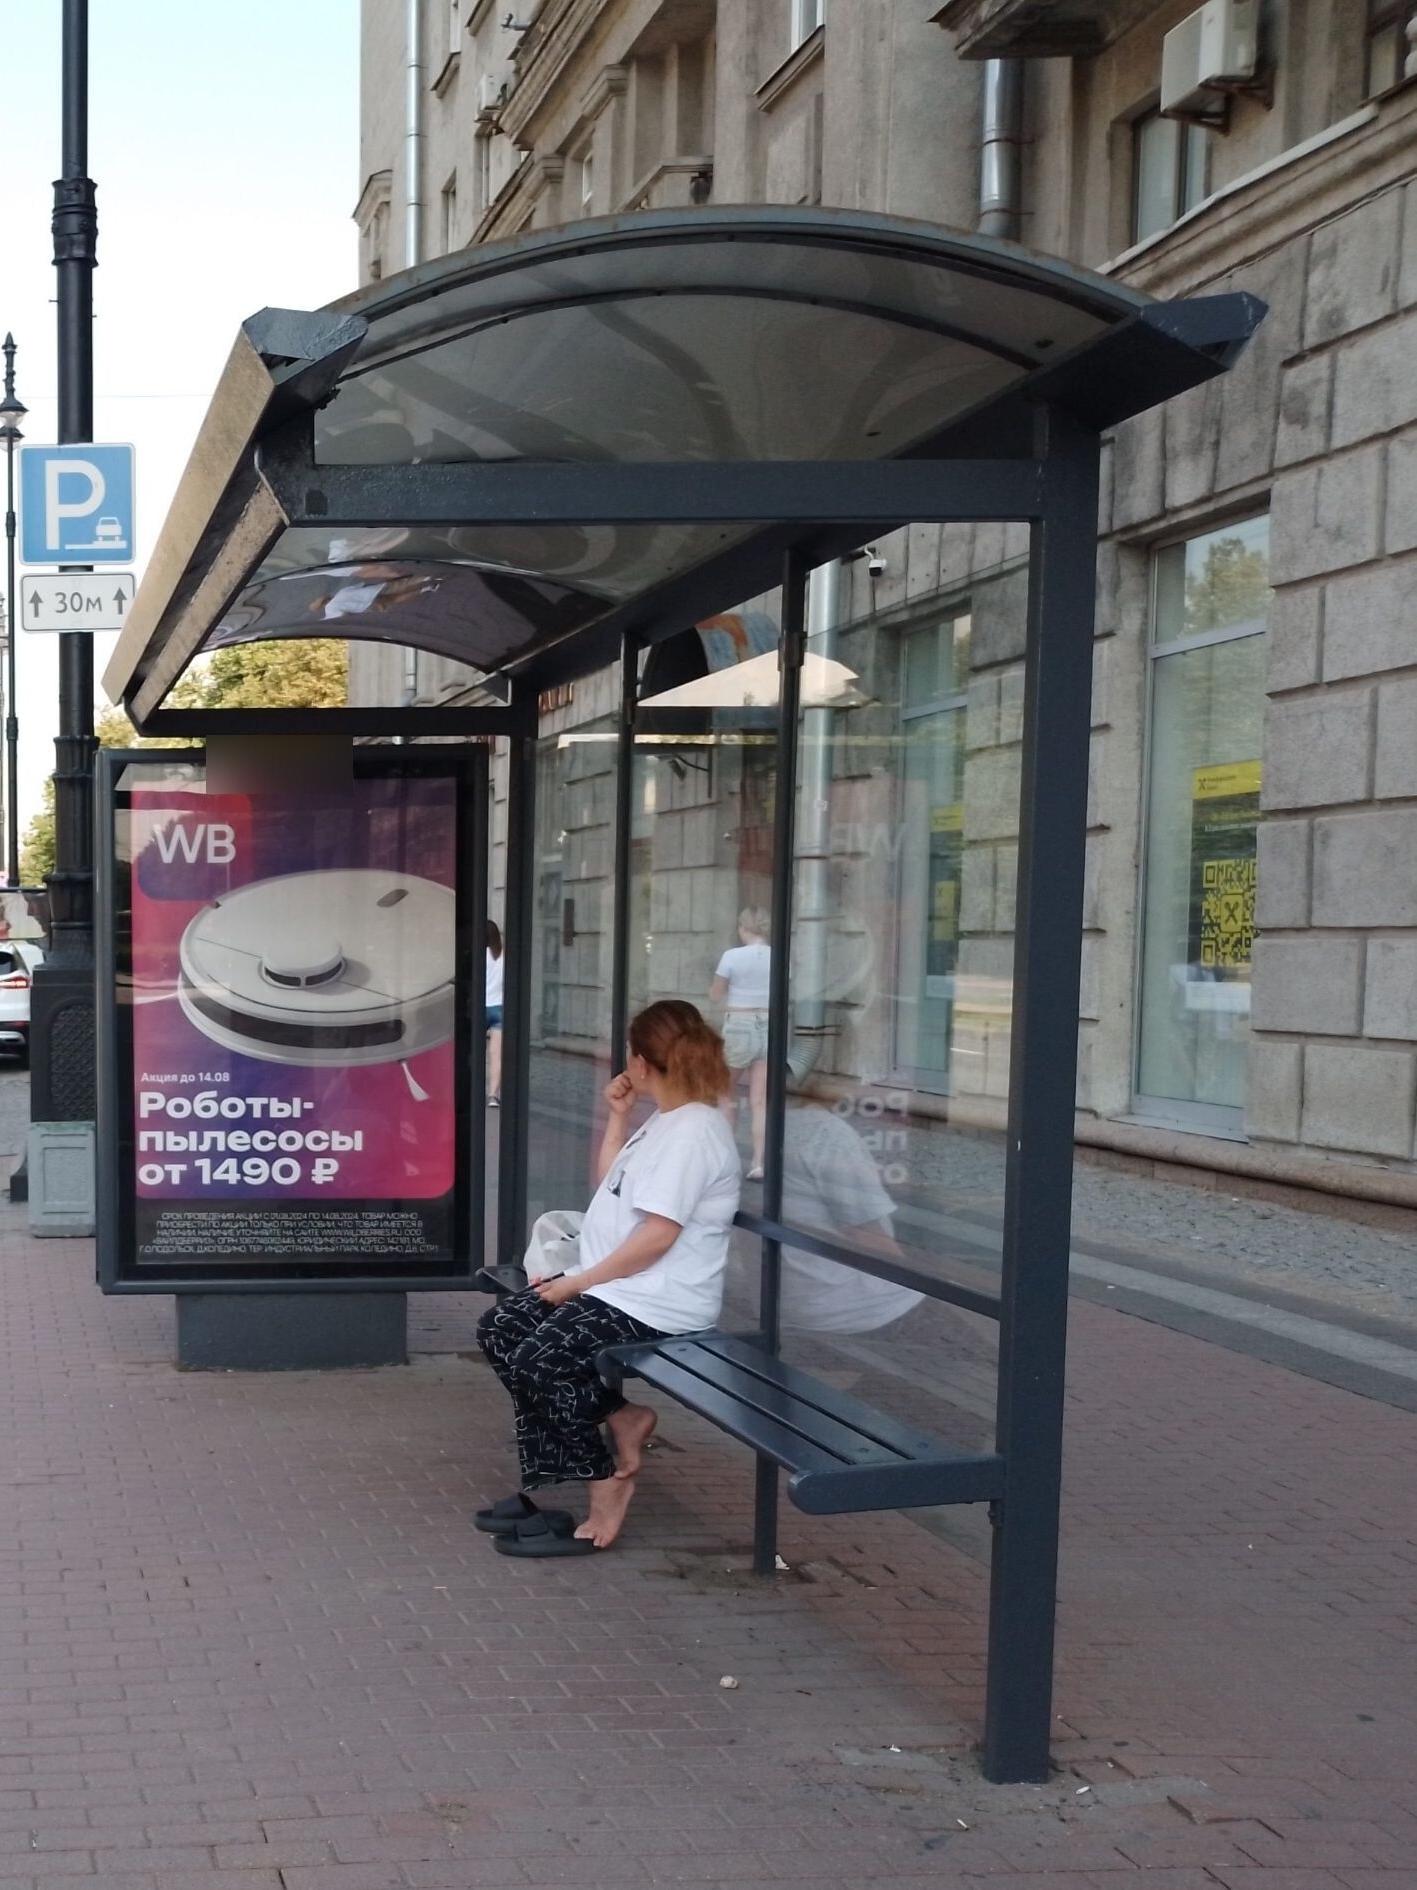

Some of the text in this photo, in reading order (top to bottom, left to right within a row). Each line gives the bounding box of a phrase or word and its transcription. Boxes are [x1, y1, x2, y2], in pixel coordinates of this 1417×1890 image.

[45, 459, 106, 550] P
[154, 823, 236, 864] WB
[140, 1072, 230, 1084] Акция до 14.08
[139, 1090, 314, 1119] Роботы-
[139, 1130, 363, 1152] пылесосы
[138, 1156, 339, 1185] от 1490 ₽
